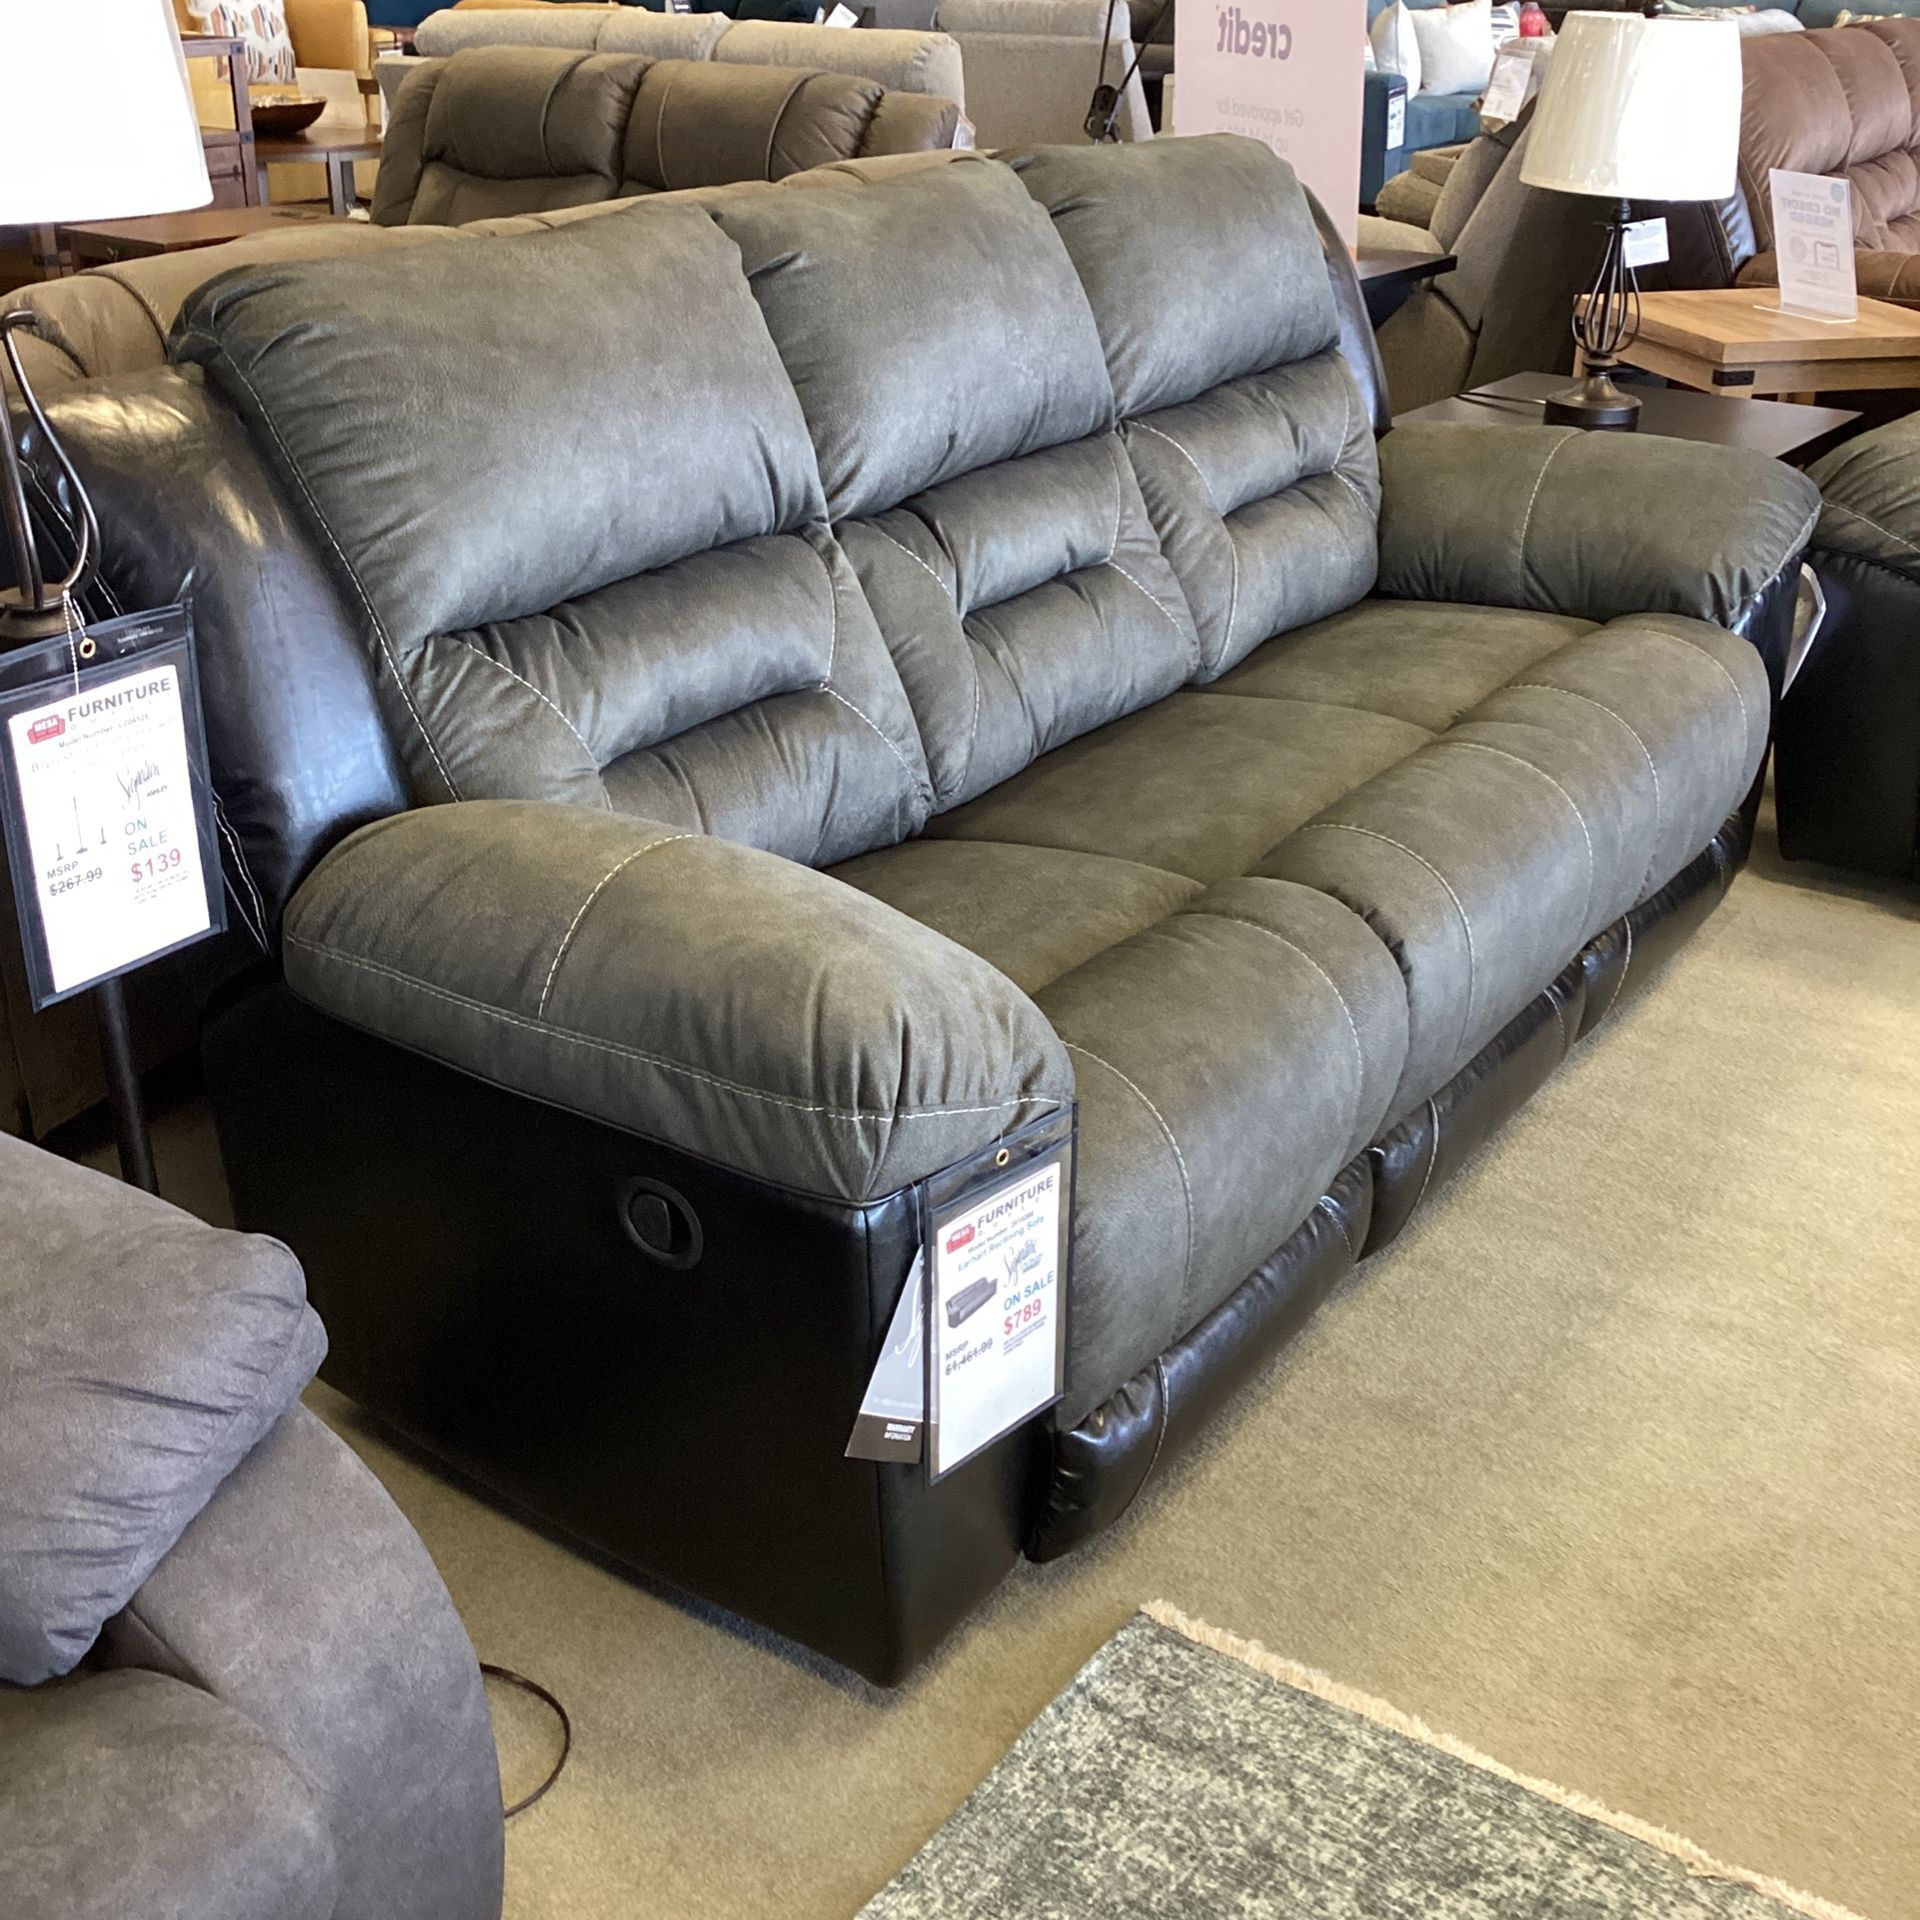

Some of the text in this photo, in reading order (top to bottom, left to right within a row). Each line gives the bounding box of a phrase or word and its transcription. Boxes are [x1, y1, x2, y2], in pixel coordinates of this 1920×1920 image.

[68, 678, 171, 722] FURNITURE
[124, 817, 147, 836] ON
[127, 829, 168, 855] SALE
[47, 860, 79, 879] MSRP
[131, 848, 181, 883] $139
[49, 867, 103, 897] $267.99
[977, 1175, 1054, 1229] FURNITURE
[1027, 1216, 1045, 1230] Sofa
[1004, 1270, 1054, 1311] ON SALE
[1004, 1298, 1042, 1336] $789
[945, 1340, 969, 1361] MSRP
